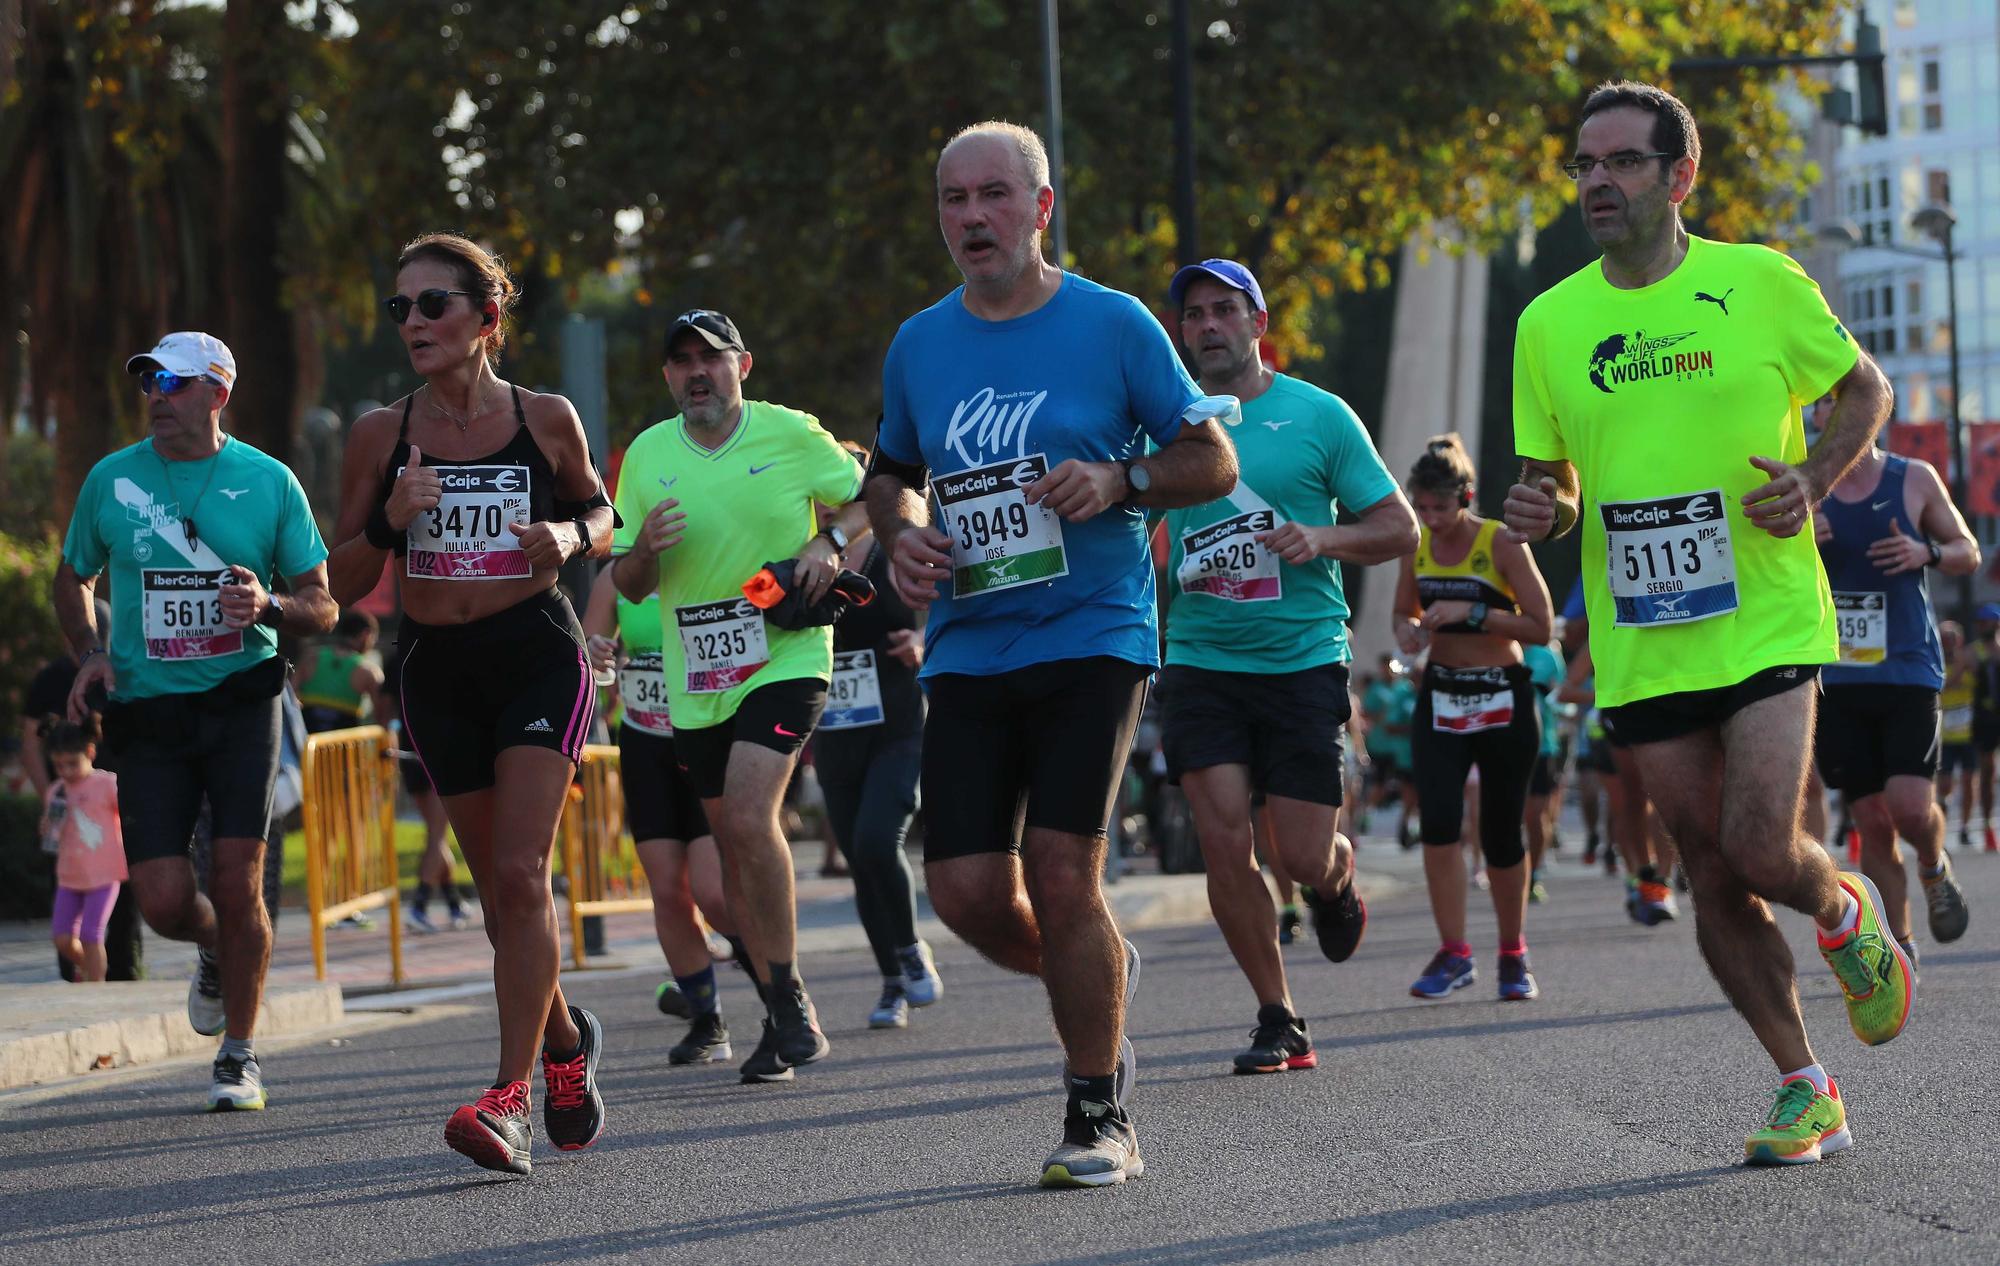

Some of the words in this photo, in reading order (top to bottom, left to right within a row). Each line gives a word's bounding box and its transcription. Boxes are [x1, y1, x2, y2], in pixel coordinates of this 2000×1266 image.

[1626, 338, 1669, 354] WINGS
[1632, 349, 1657, 361] LIFE
[1611, 355, 1673, 384] WORLD
[1674, 350, 1713, 373] RUN
[1677, 370, 1714, 382] 2016
[944, 387, 1047, 469] Run
[439, 474, 480, 490] rCaja
[943, 474, 998, 497] iberCaja
[427, 504, 502, 539] 3470
[1613, 507, 1670, 525] iberCaja
[957, 501, 1029, 551] 3949
[1697, 526, 1718, 541] 10K
[1194, 523, 1238, 548] iberCaja
[445, 541, 470, 553] JULIA
[473, 540, 487, 551] HC
[984, 546, 1006, 561] JOSE
[1199, 542, 1256, 573] 5626
[1624, 537, 1702, 581] 5113
[153, 574, 206, 588] iberCaja
[1646, 579, 1684, 594] SERGIO
[163, 599, 224, 627] 5613
[175, 628, 214, 638] BENJAMIN
[693, 629, 747, 661] 3235
[709, 658, 735, 670] DANIEL
[524, 725, 554, 733] adidas
